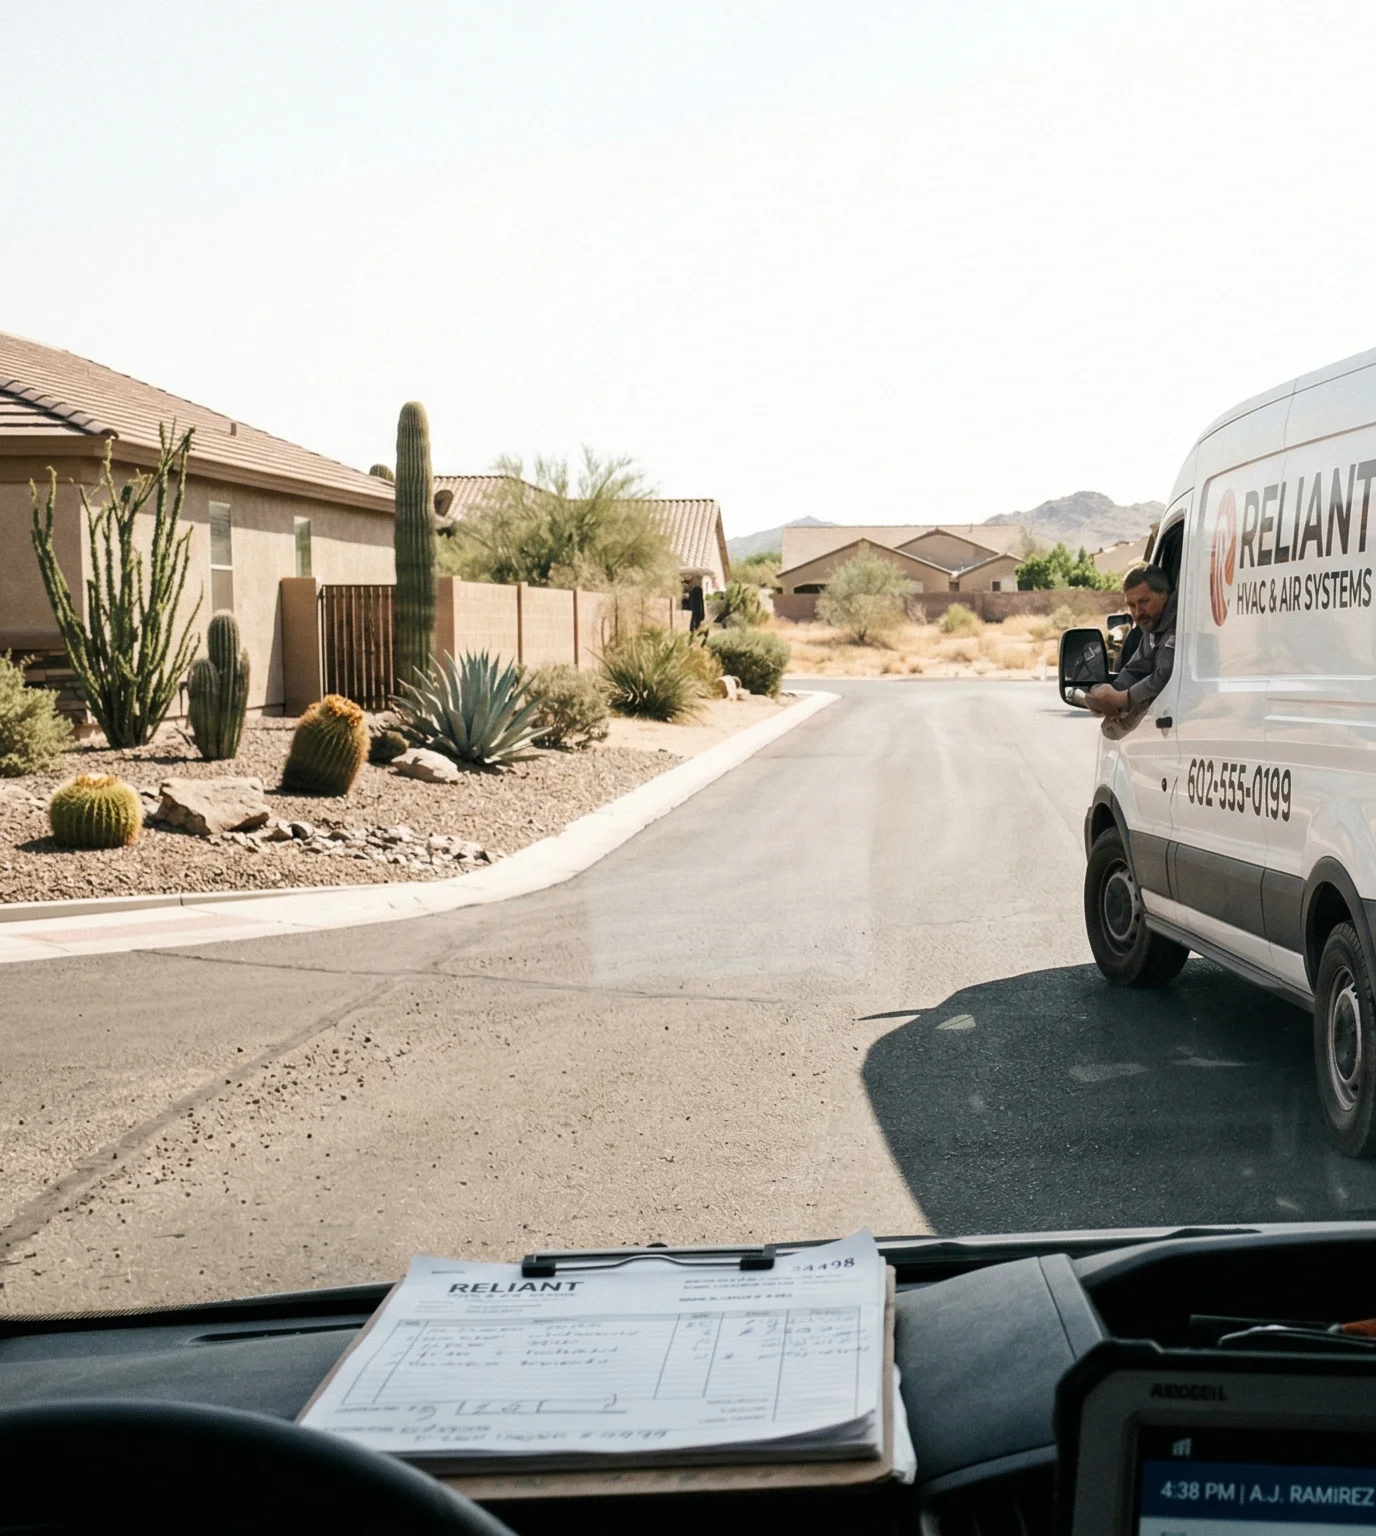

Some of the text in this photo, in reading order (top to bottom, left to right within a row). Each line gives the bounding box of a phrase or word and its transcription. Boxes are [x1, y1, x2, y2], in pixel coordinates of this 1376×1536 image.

[1236, 568, 1373, 616] HVAC & AIR SYSTEMS
[1187, 758, 1292, 822] 602-555-0199
[449, 1281, 584, 1293] RELIANT
[1160, 1480, 1200, 1500] 4:38
[1204, 1482, 1235, 1502] PM
[1249, 1484, 1284, 1504] A.J.
[1290, 1485, 1375, 1507] RAMIREZ
